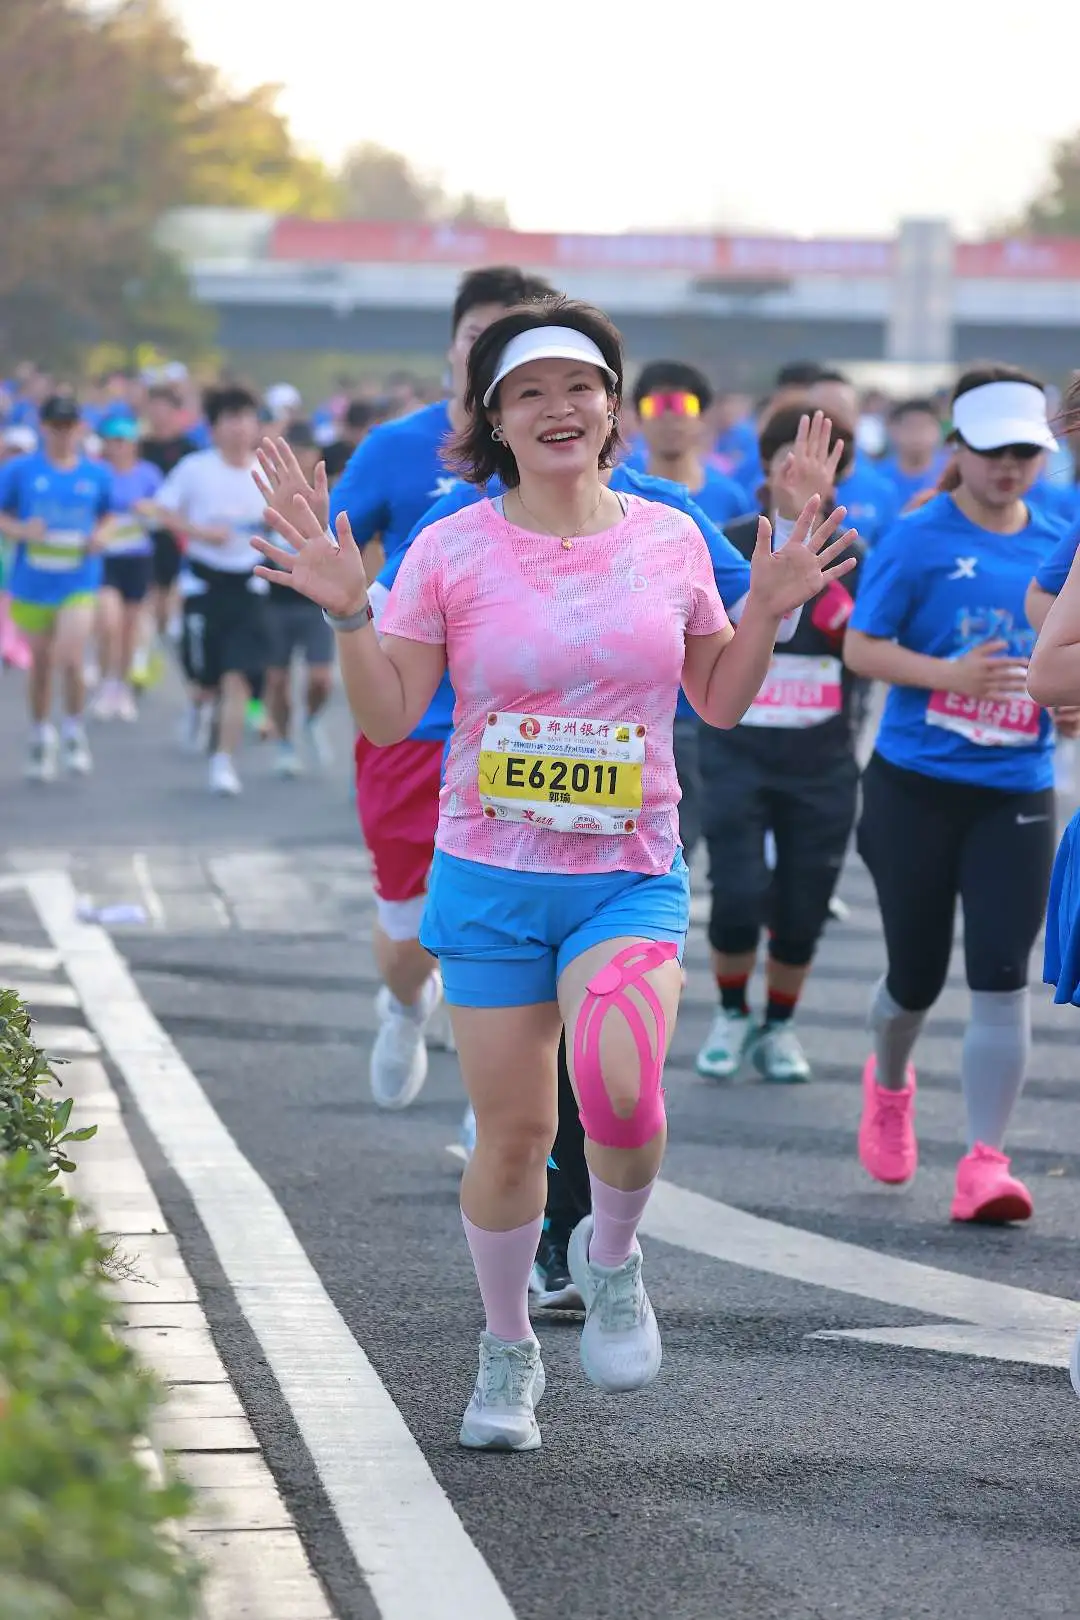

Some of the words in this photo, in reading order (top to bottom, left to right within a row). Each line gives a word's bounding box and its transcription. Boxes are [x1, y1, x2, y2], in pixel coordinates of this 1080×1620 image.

[547, 720, 610, 737] 郑州银行
[506, 757, 618, 795] E62011
